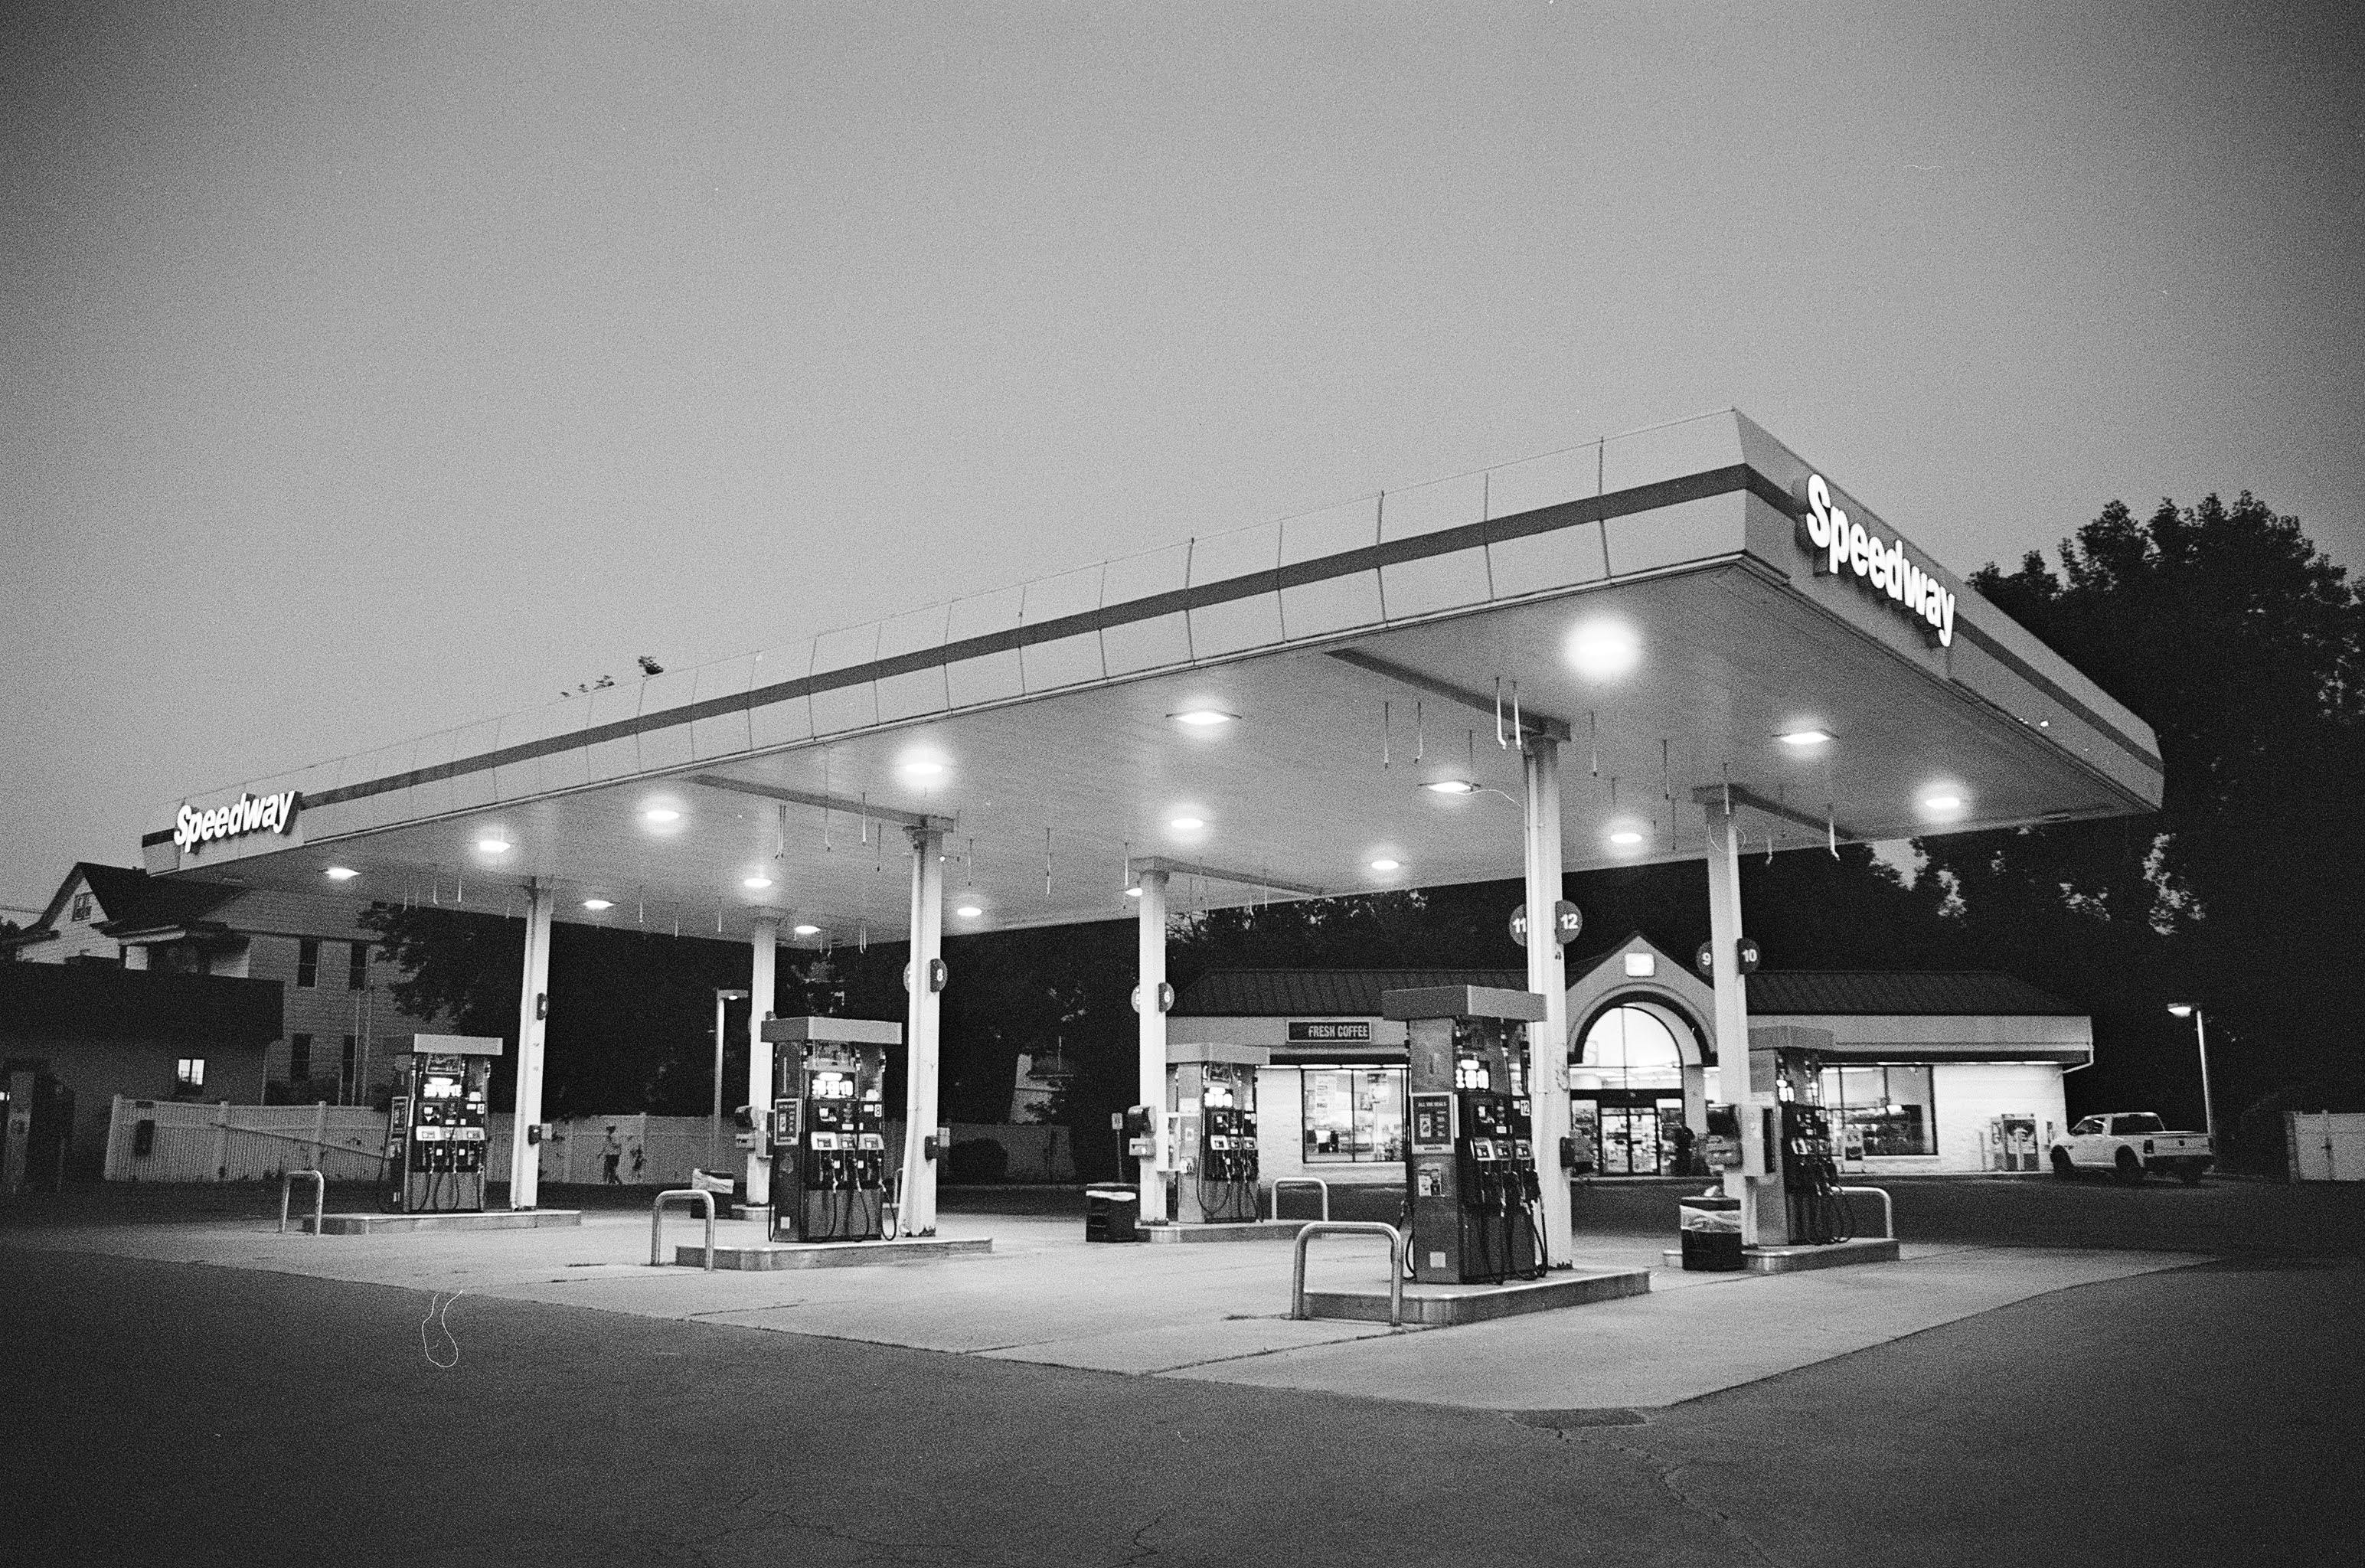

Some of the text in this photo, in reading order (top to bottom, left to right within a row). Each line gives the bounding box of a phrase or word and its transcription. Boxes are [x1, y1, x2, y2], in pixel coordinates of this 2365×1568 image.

[1805, 473, 1955, 647] Speedway
[173, 790, 296, 854] Speedway
[1513, 917, 1527, 933] 11
[1560, 913, 1578, 929] 12
[1702, 952, 1711, 965] 9
[1743, 949, 1757, 962] 10
[936, 969, 943, 982] 8
[1164, 991, 1170, 1003] 6
[1308, 1025, 1368, 1037] FRESH COFFEE
[1521, 1102, 1530, 1114] 12
